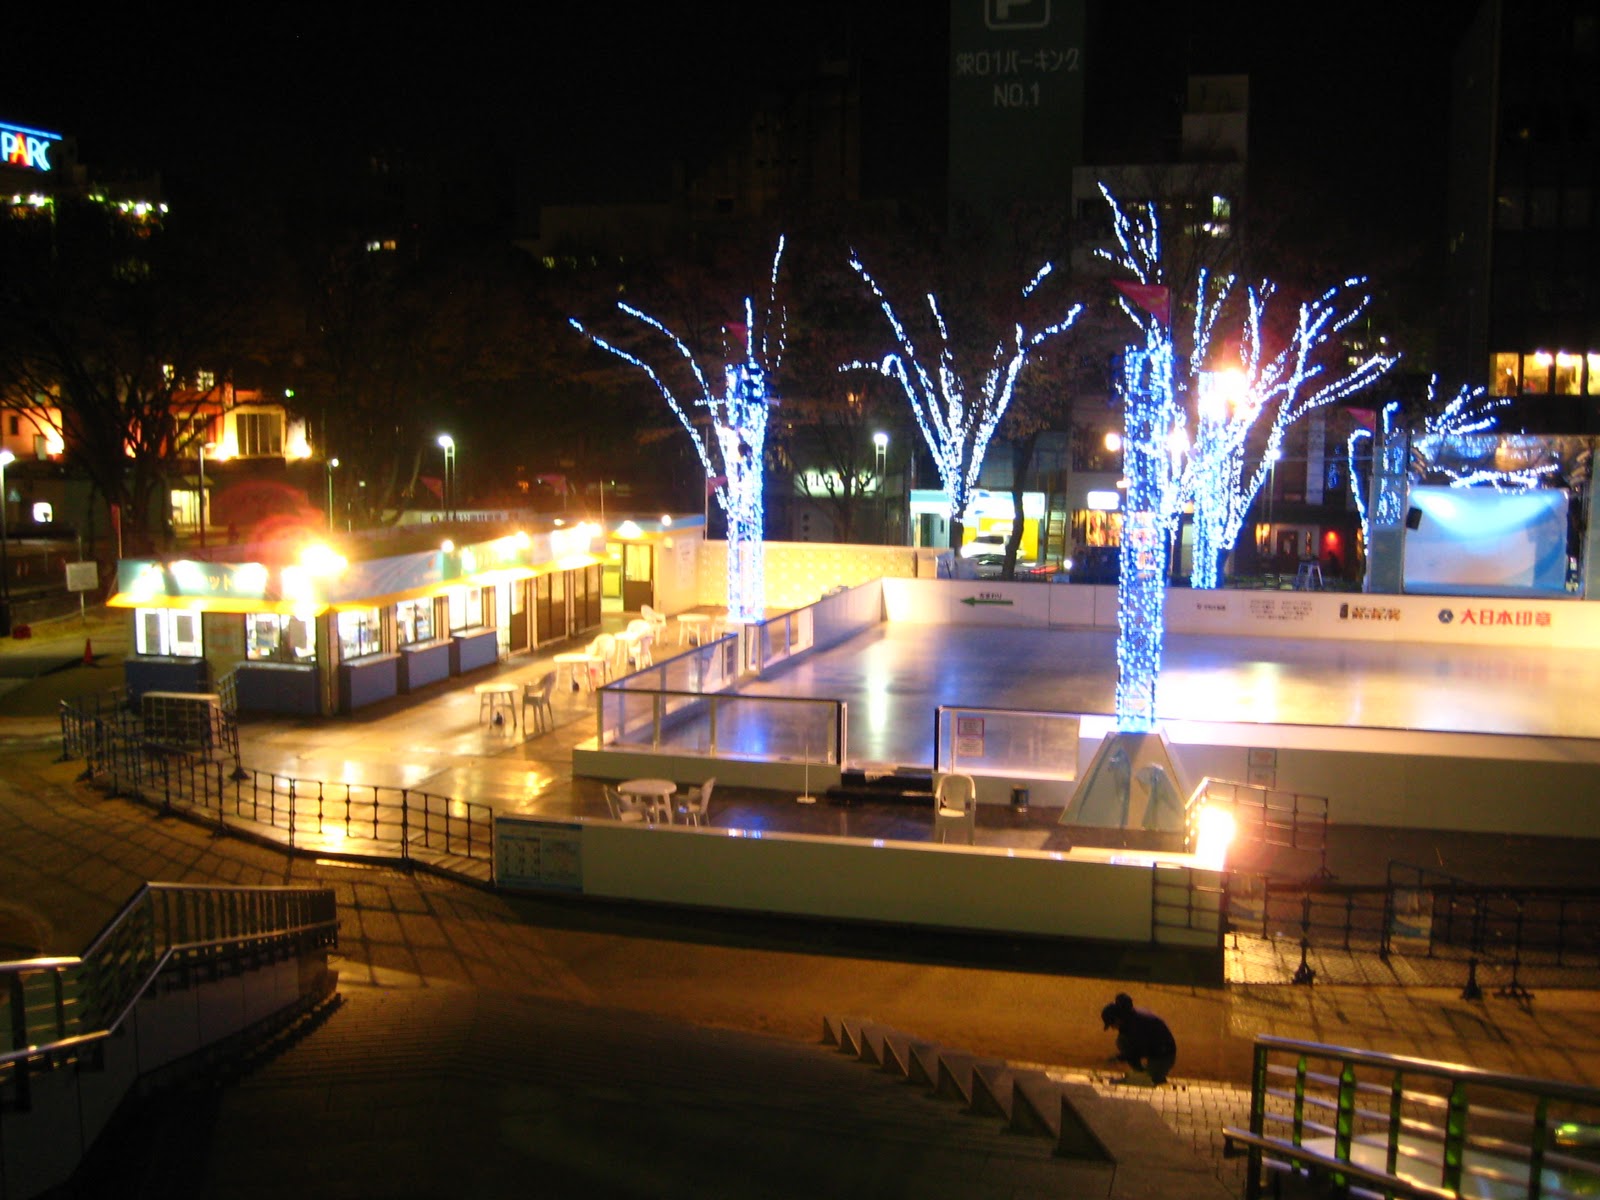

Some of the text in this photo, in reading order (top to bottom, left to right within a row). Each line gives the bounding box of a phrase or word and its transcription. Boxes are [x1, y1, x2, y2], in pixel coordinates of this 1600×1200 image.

[1460, 608, 1552, 627] 大日本印章
